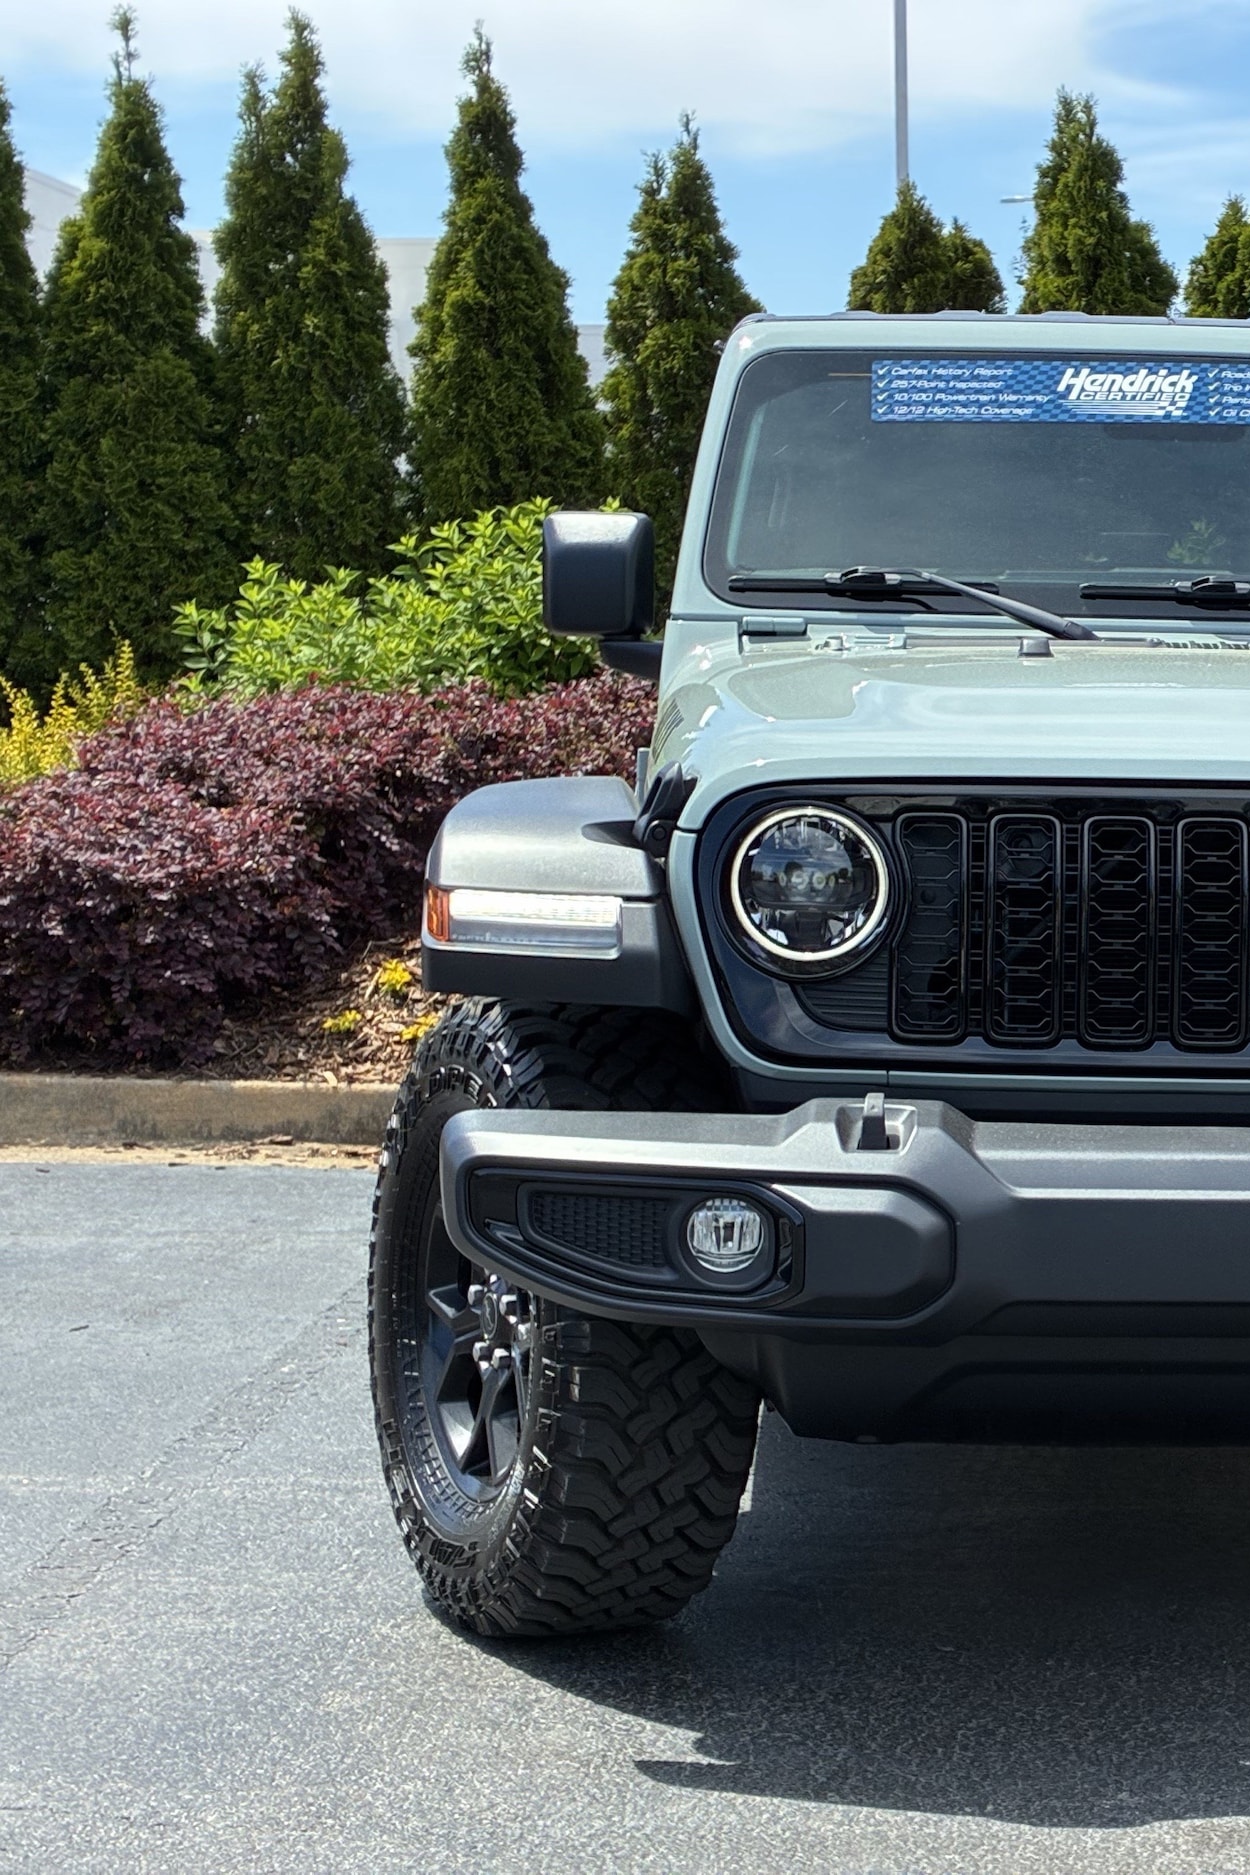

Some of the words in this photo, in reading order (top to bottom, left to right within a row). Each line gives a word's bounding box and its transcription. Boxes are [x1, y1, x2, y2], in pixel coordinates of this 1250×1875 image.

[891, 367, 928, 377] Carfax
[931, 367, 972, 377] History
[973, 367, 1013, 377] Report
[1056, 368, 1198, 400] Hendrick
[1223, 384, 1243, 392] Trip
[893, 393, 933, 402] 10/100
[934, 393, 996, 402] Powertrain
[1080, 391, 1191, 401] CERTIFIED
[893, 405, 926, 415] 12/12
[1223, 409, 1238, 417] Oil
